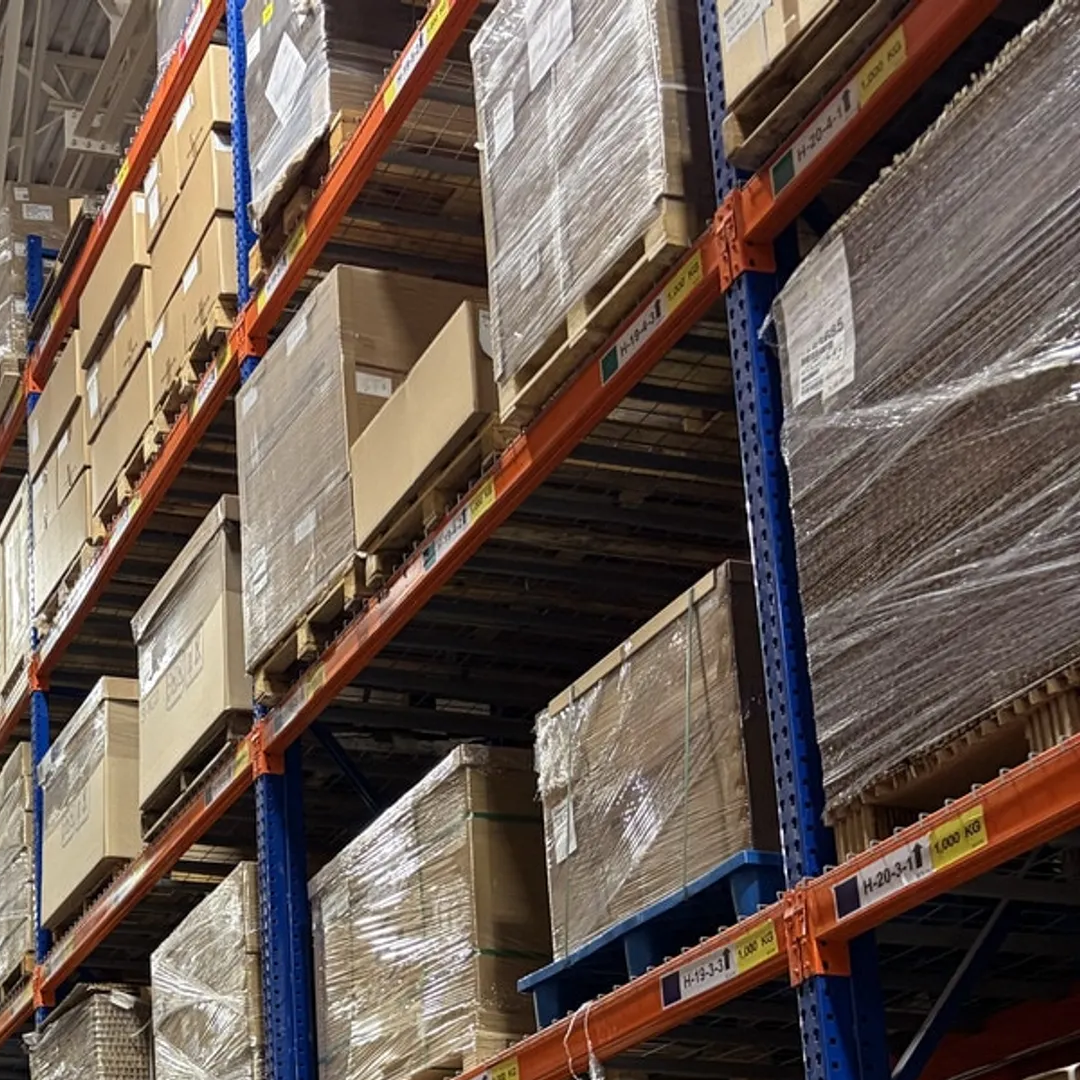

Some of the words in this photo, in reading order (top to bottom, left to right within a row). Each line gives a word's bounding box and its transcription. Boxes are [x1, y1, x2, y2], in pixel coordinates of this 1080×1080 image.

[862, 853, 914, 896] H-20-3-1
[933, 831, 961, 854] 1,000
[963, 819, 981, 838] KG
[683, 957, 724, 988] H-19-3-3
